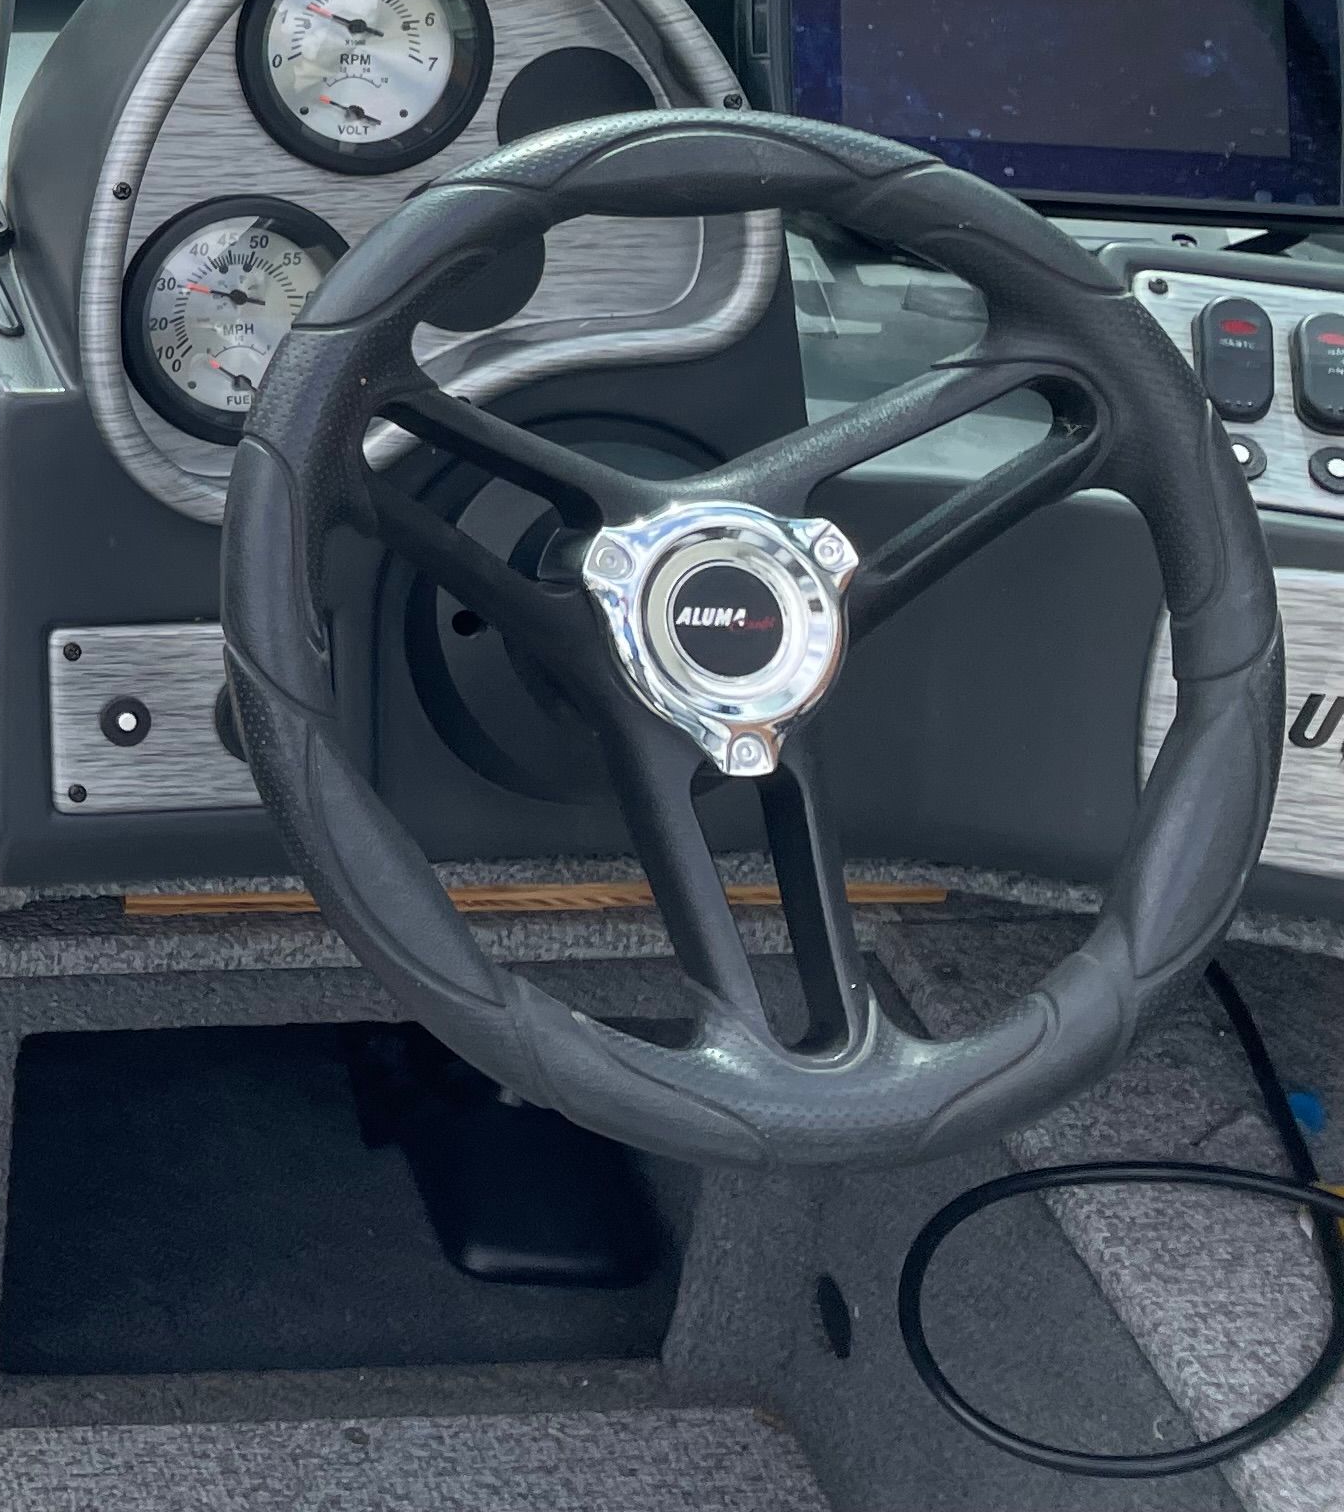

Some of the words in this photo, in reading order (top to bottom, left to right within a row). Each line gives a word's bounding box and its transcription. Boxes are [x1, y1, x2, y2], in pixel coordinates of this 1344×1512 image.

[280, 9, 289, 24] 1
[425, 12, 435, 26] 6
[272, 54, 282, 68] 0
[340, 53, 371, 65] RPM
[428, 57, 438, 71] 7
[337, 124, 369, 136] VOLT
[249, 235, 269, 249] 50
[189, 242, 209, 257] 40
[282, 252, 303, 266] 55
[156, 277, 176, 291] 30
[149, 317, 168, 331] 20
[223, 323, 254, 336] MPH
[156, 346, 174, 360] 10
[171, 359, 182, 372] 0
[226, 394, 251, 406] FUE
